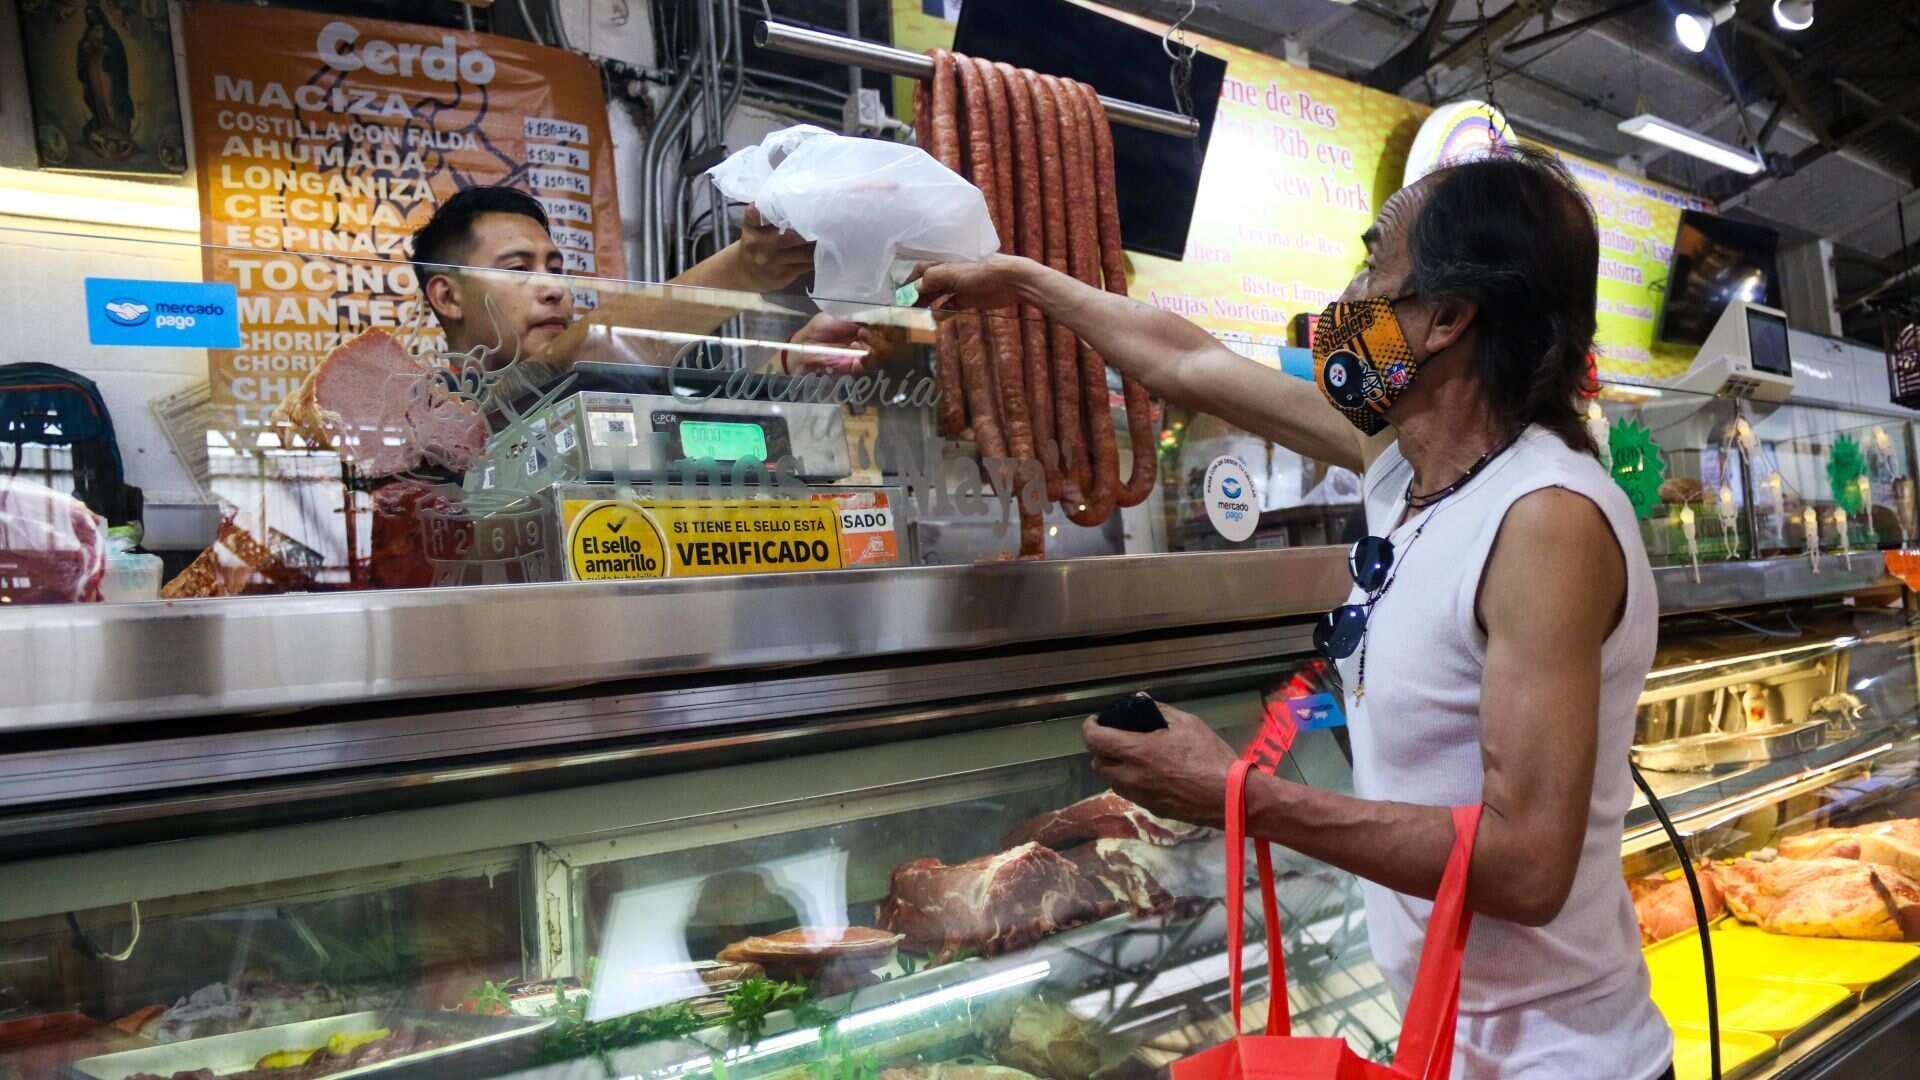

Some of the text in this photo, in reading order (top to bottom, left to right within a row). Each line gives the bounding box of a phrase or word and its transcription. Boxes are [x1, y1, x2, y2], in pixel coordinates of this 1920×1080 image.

[317, 22, 496, 85] Cerdo
[214, 75, 413, 118] MACIZA
[1266, 84, 1292, 115] de
[1299, 93, 1336, 128] Res
[217, 109, 479, 152] COSTILLA CON FALDA
[222, 136, 427, 173] AHUMADA
[1274, 127, 1352, 173] Rib eye
[221, 164, 436, 203] LONGANIZA
[1321, 176, 1369, 212] York
[224, 194, 401, 227] CECINA
[229, 260, 420, 295] TOCINO
[155, 303, 224, 316] mercado
[155, 314, 196, 330] pago
[1150, 289, 1287, 324] Agujas Norteñas
[1322, 307, 1375, 357] Steelers
[667, 340, 945, 407] Carnicería
[1217, 501, 1249, 512] mercado
[1225, 511, 1243, 522] pago
[673, 517, 826, 534] SI TIENE EL SELLO ESTÁ
[582, 535, 642, 554] El sello
[676, 539, 830, 567] VERIFICADO
[585, 554, 656, 572] amarillo
